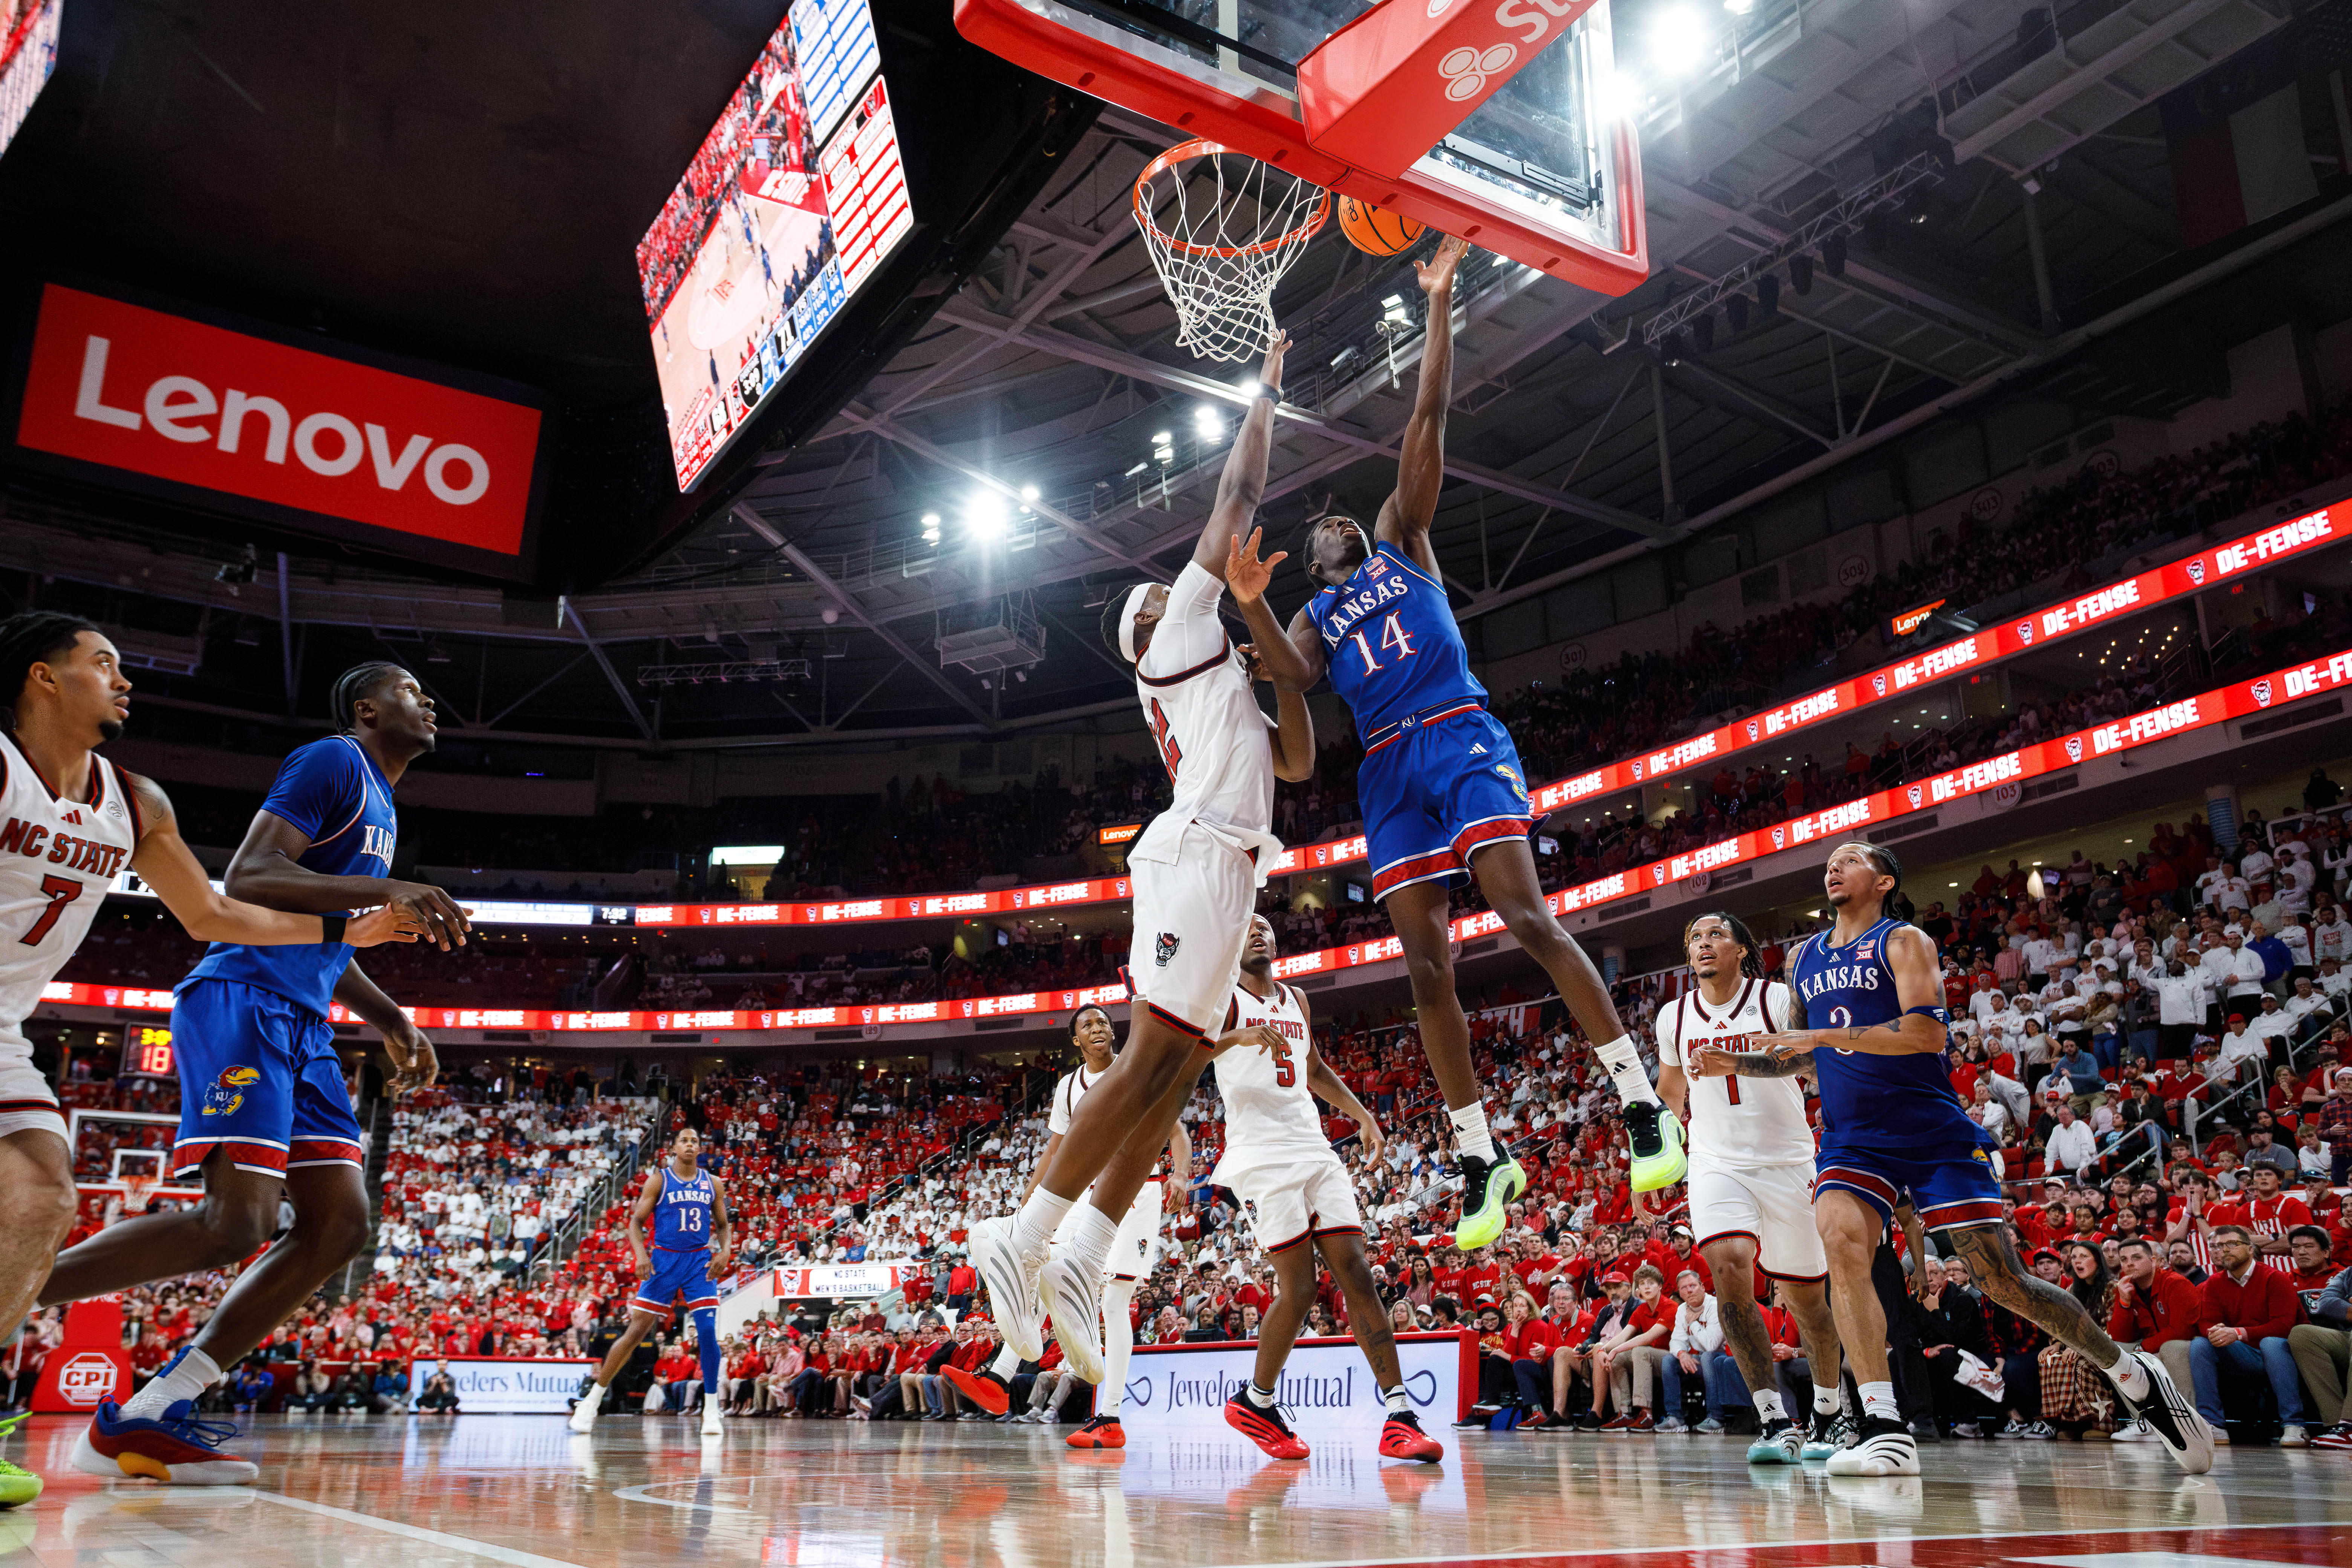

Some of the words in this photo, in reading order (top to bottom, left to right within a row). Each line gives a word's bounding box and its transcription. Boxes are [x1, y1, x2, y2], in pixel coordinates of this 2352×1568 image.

[777, 321, 794, 353] 71
[75, 333, 490, 506] Lenovo
[711, 400, 727, 432] 68
[2216, 511, 2332, 574] DE-FENSE
[1322, 575, 1408, 651] KANSAS
[2043, 580, 2139, 636] DE-FENSE
[1897, 611, 1932, 632] Leno
[1348, 609, 1418, 677] 14
[1894, 638, 1977, 688] DE-FENSE
[2285, 652, 2352, 697] DE-F
[1402, 714, 1415, 728] KU
[1766, 689, 1838, 734] DE-FENSE
[2093, 698, 2199, 754] DE-FENSE
[1650, 733, 1716, 774] DE-FENSE
[1931, 752, 2021, 802] DE-FENSE
[1541, 771, 1602, 808] DE-FENSE
[1996, 783, 2017, 801] 103
[1792, 798, 1870, 843] DE-FENSE
[0, 818, 47, 858] NC
[47, 832, 127, 878] STATE
[360, 825, 393, 870] KANS
[1333, 837, 1367, 861] DE-FE
[1671, 838, 1739, 879] DE-FENSE
[1565, 873, 1624, 910] DE-FENSE
[1691, 874, 1707, 888] 102
[926, 894, 987, 913] DE-FENSE
[1029, 883, 1088, 905] DE-FENSE
[19, 873, 83, 947] 7
[601, 907, 627, 920] 7:32
[717, 906, 778, 922] DE-FENSE
[823, 901, 882, 920] DE-FENSE
[1365, 937, 1403, 961] DE-FE
[1079, 984, 1128, 1006] DE-FENS
[1800, 965, 1879, 1003] KANSAS
[123, 990, 177, 1007] DE-FE
[978, 994, 1036, 1015] DE-FENSE
[460, 1011, 524, 1026] DE-FENSE
[568, 1012, 630, 1028] DE-FENSE
[673, 1011, 734, 1028] DE-FENSE
[777, 1008, 836, 1026] DE-FENSE
[878, 1002, 937, 1022] DE-FENSE
[1270, 1020, 1304, 1040] STATE
[140, 1045, 171, 1073] 18
[1275, 1044, 1296, 1088] 5
[667, 1190, 711, 1205] KANSAS
[678, 1208, 701, 1232] 13
[834, 1270, 844, 1278] NC
[845, 1269, 866, 1278] STATE
[1480, 1280, 1492, 1290] STAT
[839, 1282, 885, 1293] BASKETBALL
[65, 1371, 110, 1387] CPI
[517, 1370, 584, 1394] Mutua
[1166, 1371, 1250, 1412] Jeweler
